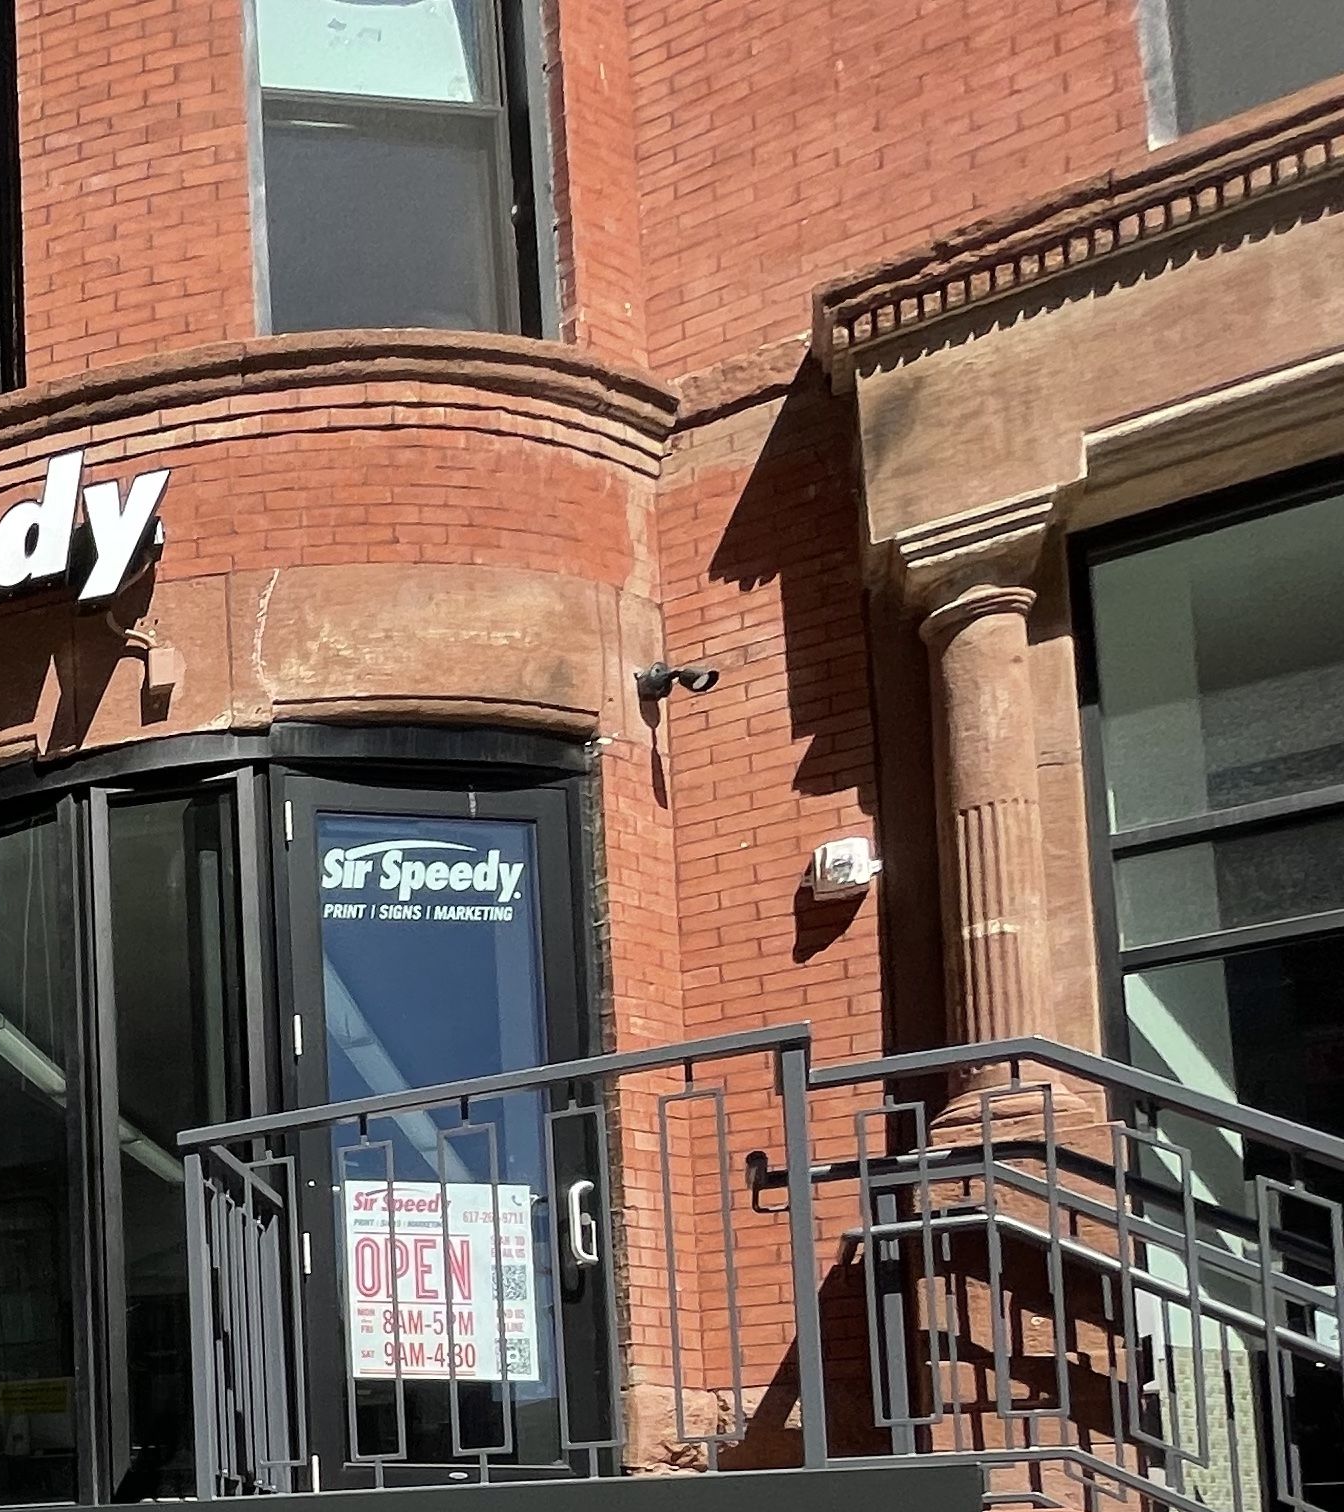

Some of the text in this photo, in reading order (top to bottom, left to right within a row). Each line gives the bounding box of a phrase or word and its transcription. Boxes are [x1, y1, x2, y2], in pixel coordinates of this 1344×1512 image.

[321, 847, 374, 890] Sir
[322, 903, 513, 922] PRINT SIGNS MARKETING
[353, 1191, 452, 1219] Sir Speed
[355, 1236, 473, 1300] OPEN
